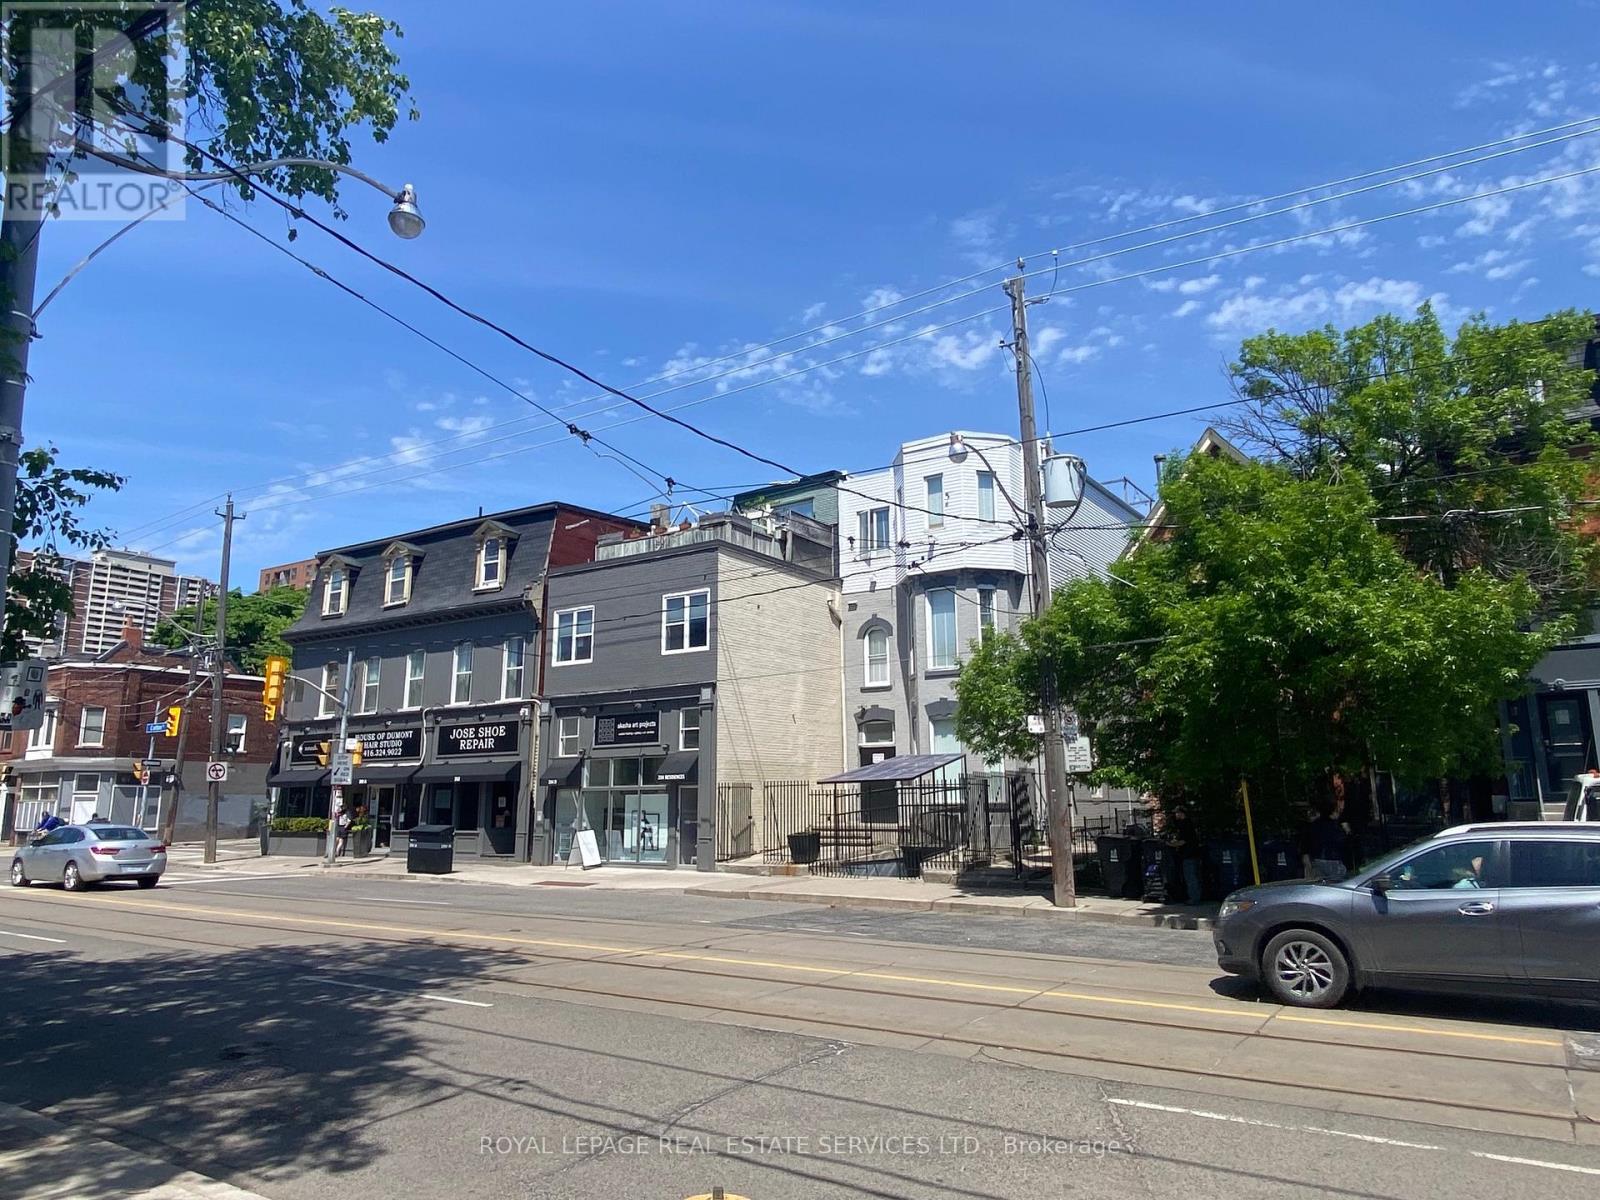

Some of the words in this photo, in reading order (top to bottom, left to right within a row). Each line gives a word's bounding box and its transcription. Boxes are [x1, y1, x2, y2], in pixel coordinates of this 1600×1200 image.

[376, 732, 386, 740] OF
[386, 730, 414, 740] DUMONT
[449, 728, 476, 740] JOSE
[477, 726, 506, 738] SHOE
[363, 741, 379, 749] HAIR
[379, 740, 403, 748] STUDIO
[459, 738, 495, 750] REPAIR
